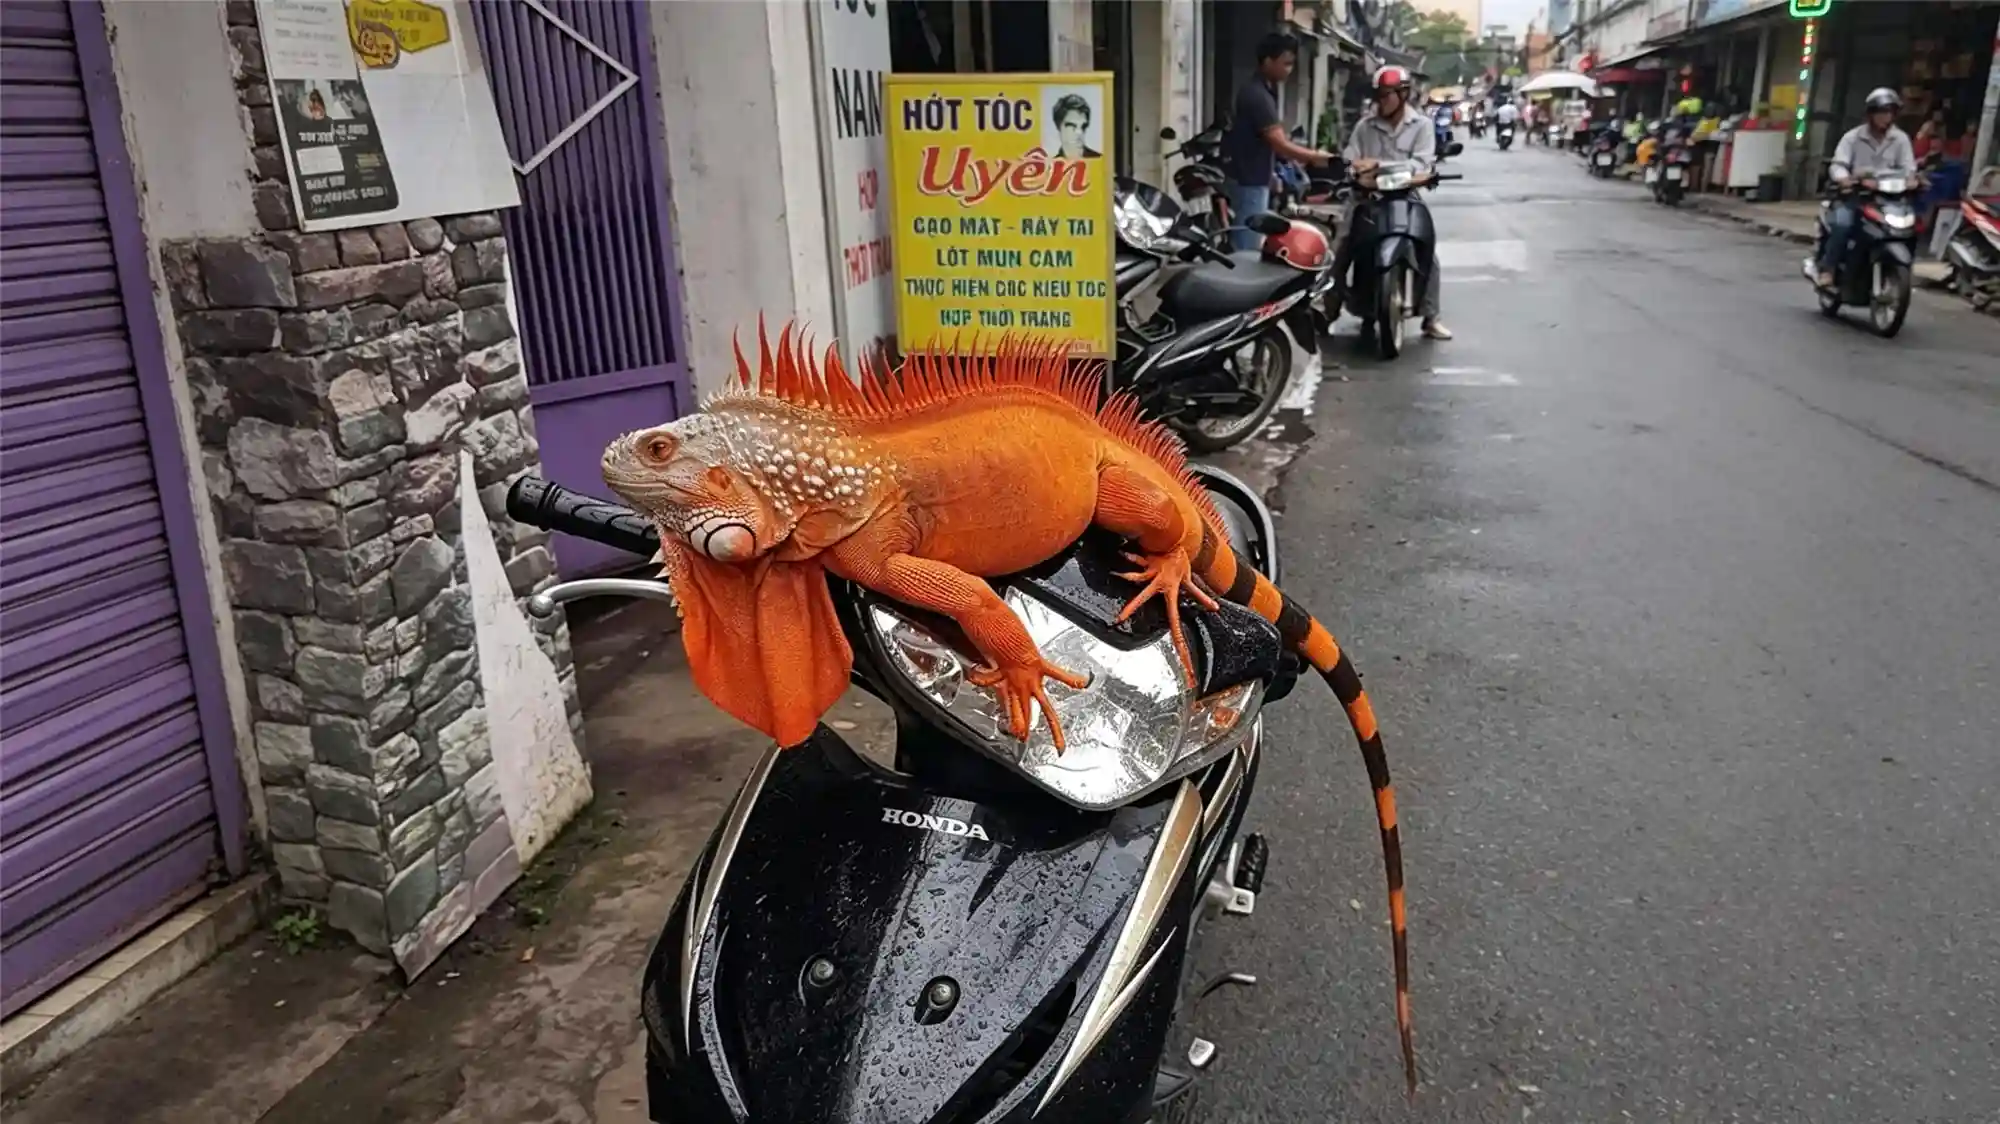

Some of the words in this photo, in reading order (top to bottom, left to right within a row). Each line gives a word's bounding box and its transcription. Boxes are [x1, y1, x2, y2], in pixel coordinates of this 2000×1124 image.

[973, 91, 1033, 131] TÓC
[918, 146, 1091, 208] Uyên
[881, 807, 990, 841] HONDA
